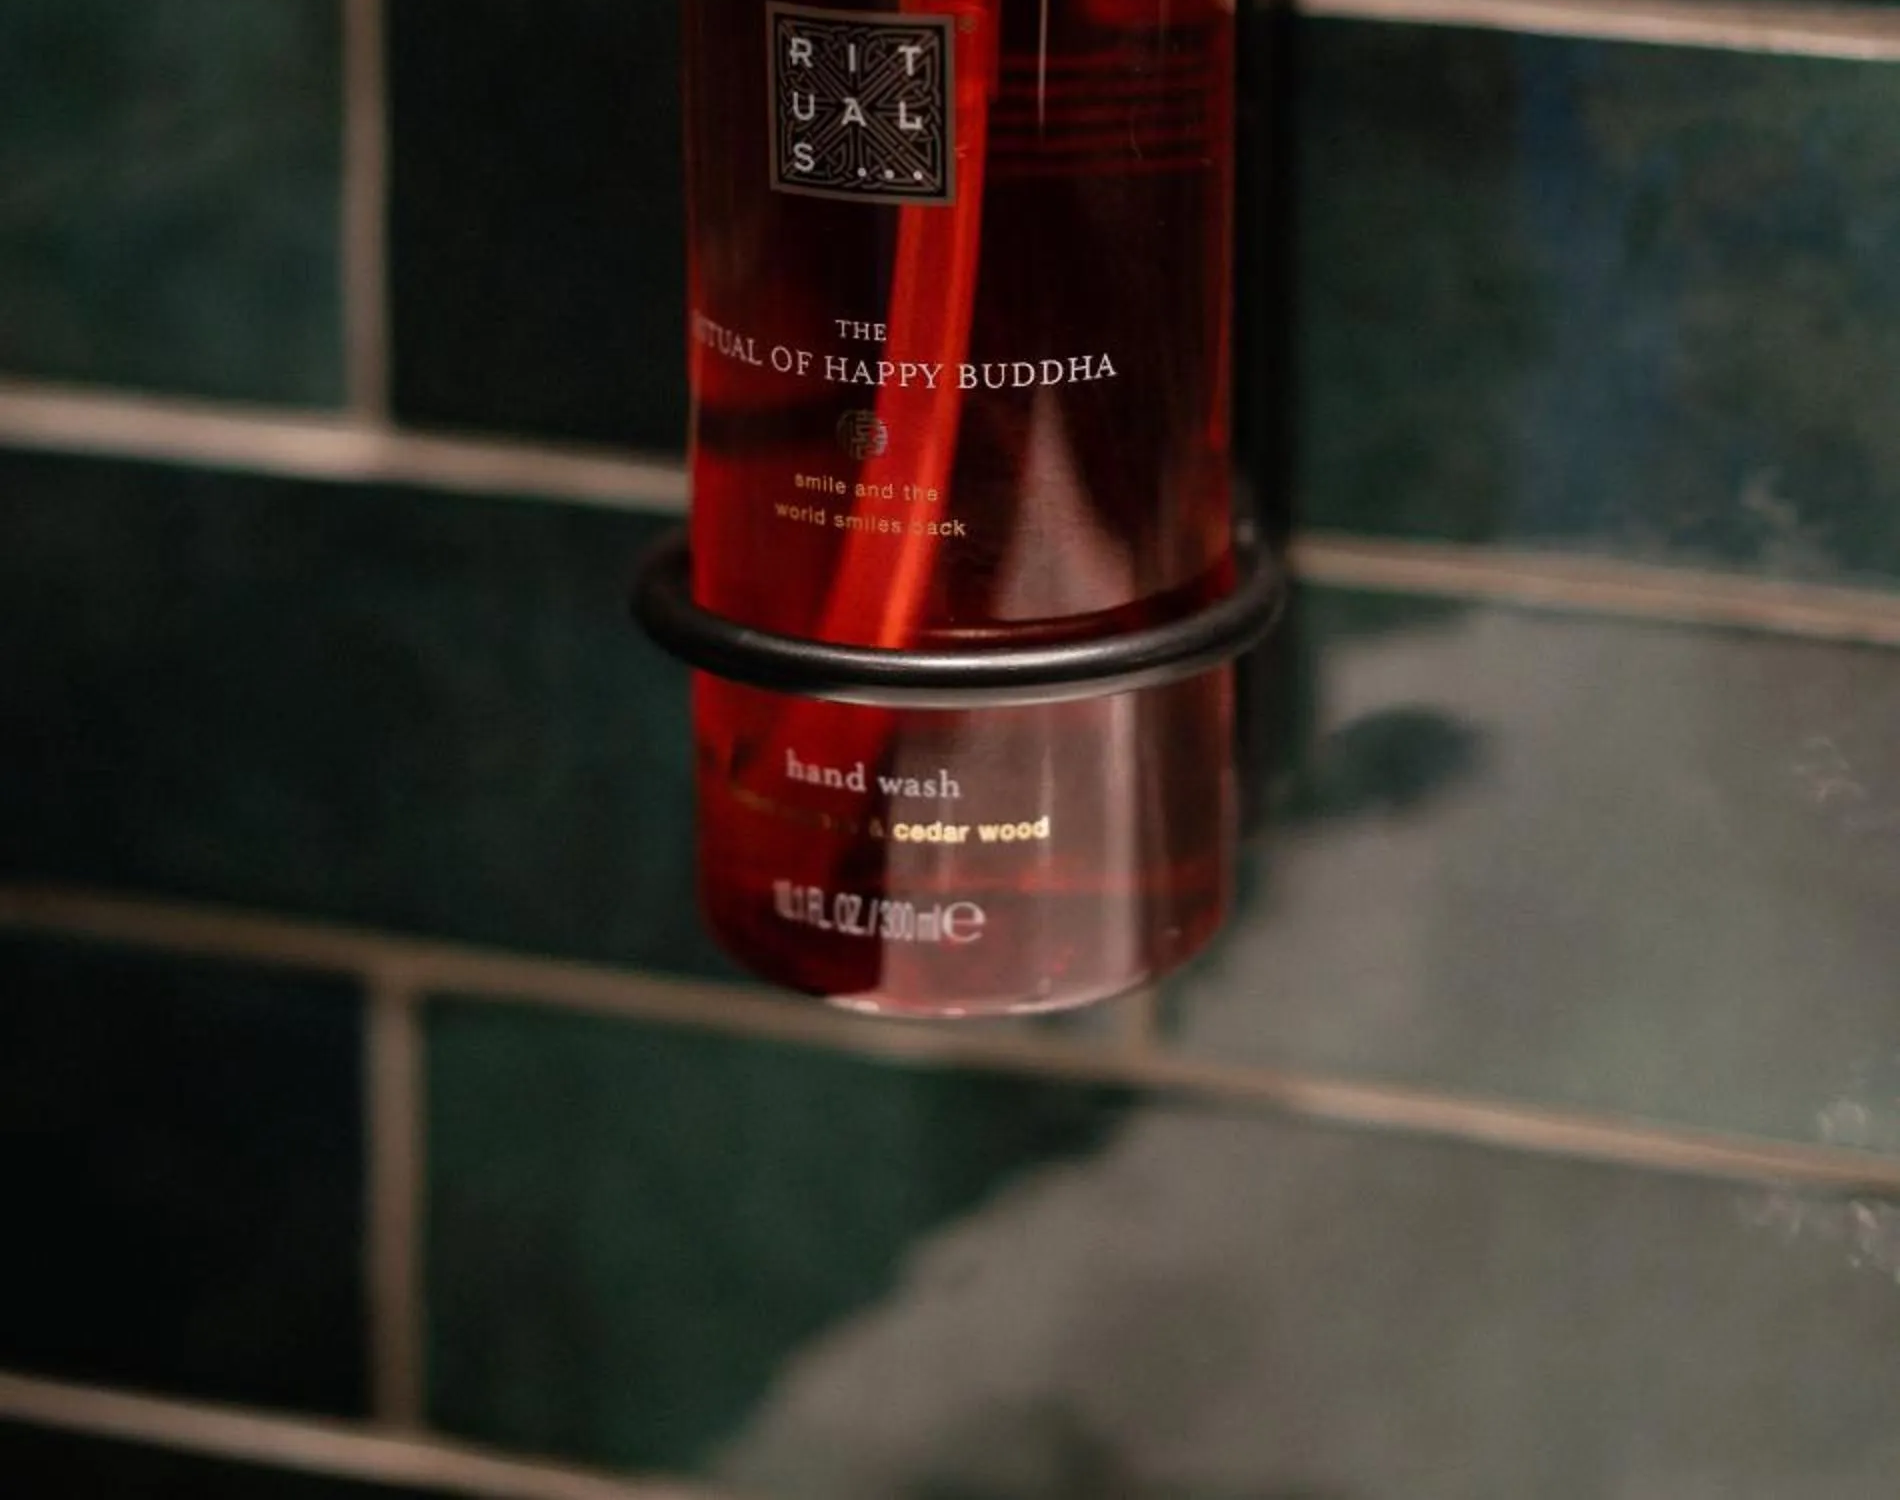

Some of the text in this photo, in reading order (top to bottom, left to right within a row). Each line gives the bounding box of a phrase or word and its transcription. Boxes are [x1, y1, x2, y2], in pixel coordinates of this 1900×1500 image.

[789, 37, 922, 77] RIT
[792, 91, 923, 130] UAL
[835, 319, 887, 342] THE
[770, 346, 813, 376] OF
[824, 355, 943, 390] HAPPY
[957, 352, 1119, 390] BUDDHA
[793, 471, 939, 502] smile and the
[774, 500, 825, 527] world
[833, 511, 901, 534] smiles
[785, 747, 961, 799] hand wash
[893, 819, 971, 843] cedar
[978, 815, 1051, 842] wood
